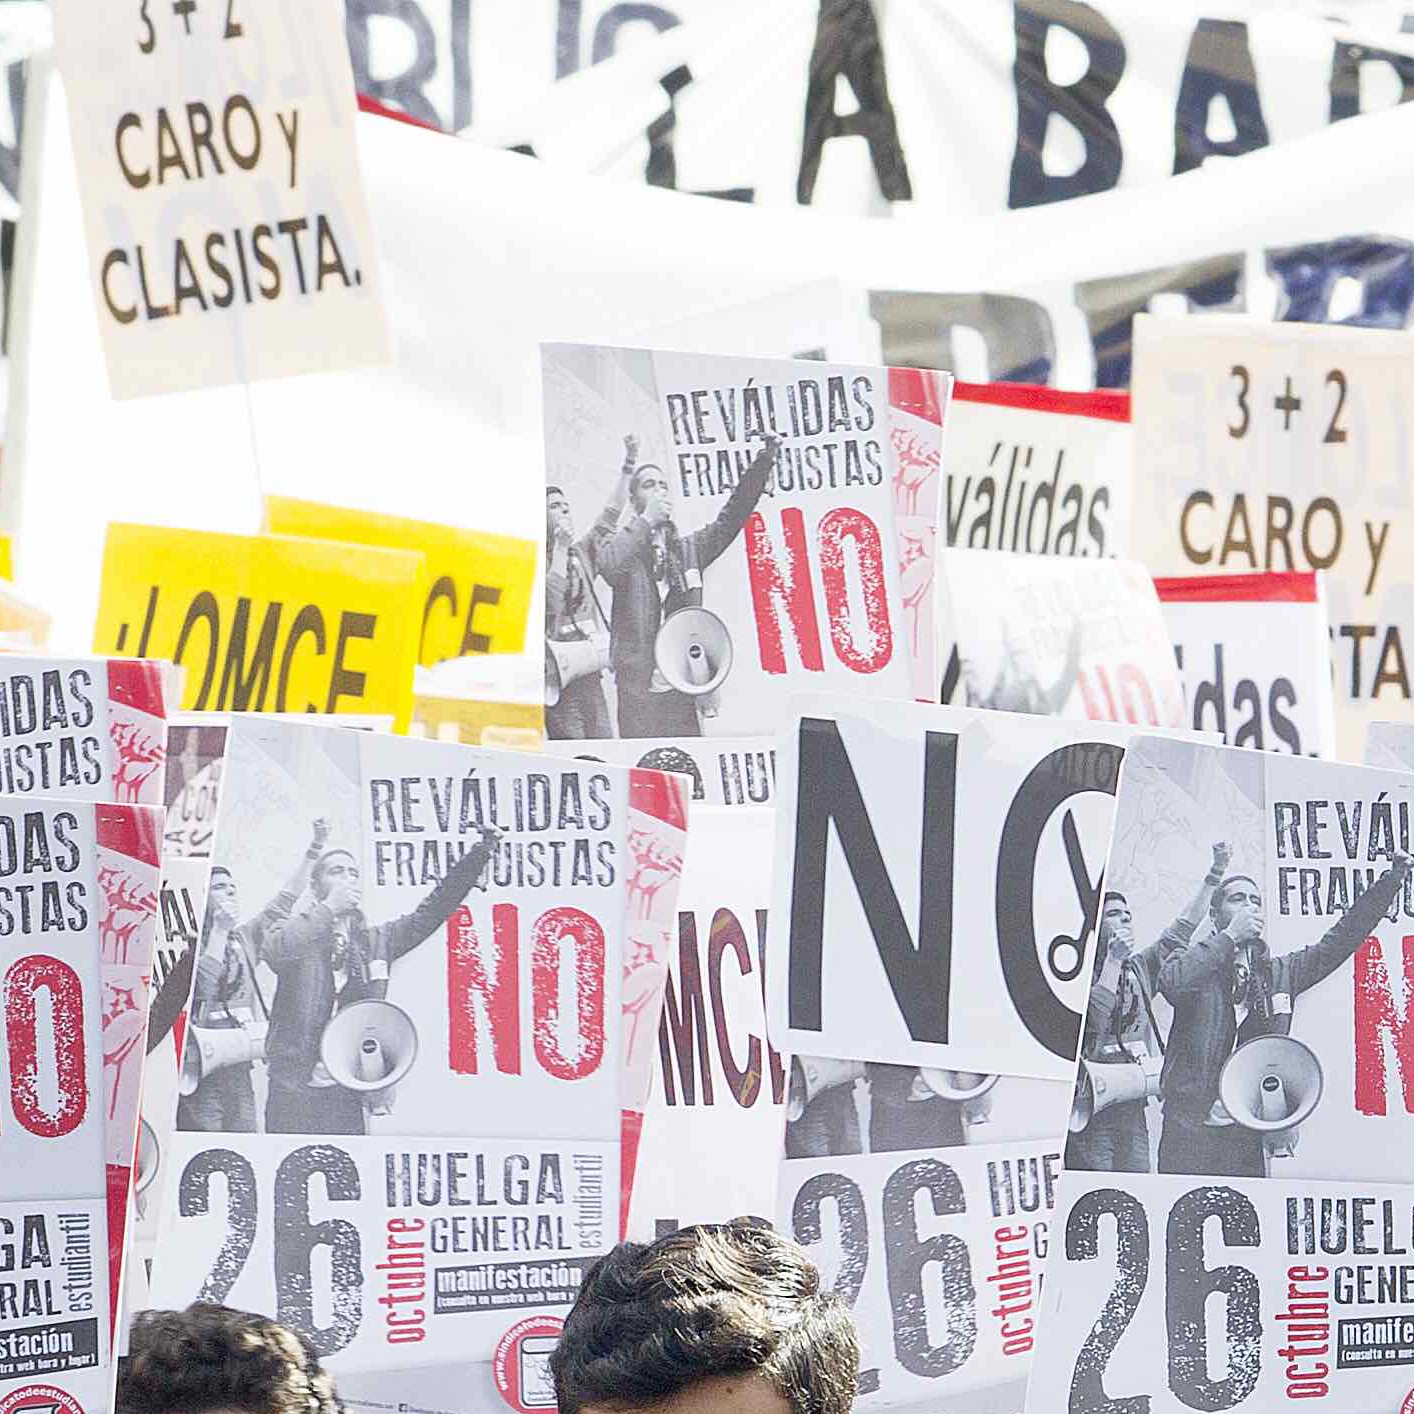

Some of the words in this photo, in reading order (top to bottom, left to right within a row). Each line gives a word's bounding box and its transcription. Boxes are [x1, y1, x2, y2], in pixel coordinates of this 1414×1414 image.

[116, 93, 261, 189] CARO
[277, 108, 299, 188] y
[101, 214, 360, 325] CLASISTA.
[667, 375, 874, 446] REVÁLIDAS
[1228, 365, 1251, 439] 3
[1274, 377, 1301, 430] +
[1323, 370, 1347, 444] 2
[745, 507, 893, 675] NO
[1180, 490, 1343, 571] CARO
[1365, 521, 1390, 596] y
[370, 769, 612, 834] REVÁLIDAS
[448, 905, 605, 1080] NO
[59, 1212, 92, 1313] estudiantil
[179, 1145, 363, 1357] 26
[386, 1153, 564, 1208] HUELGA
[572, 1154, 604, 1248] estudiantil
[376, 1216, 425, 1343] octubre
[431, 1214, 572, 1253] GENERAL
[438, 1262, 581, 1293] manifestación
[987, 1224, 1035, 1357] octubre
[1274, 1266, 1329, 1399] octubre
